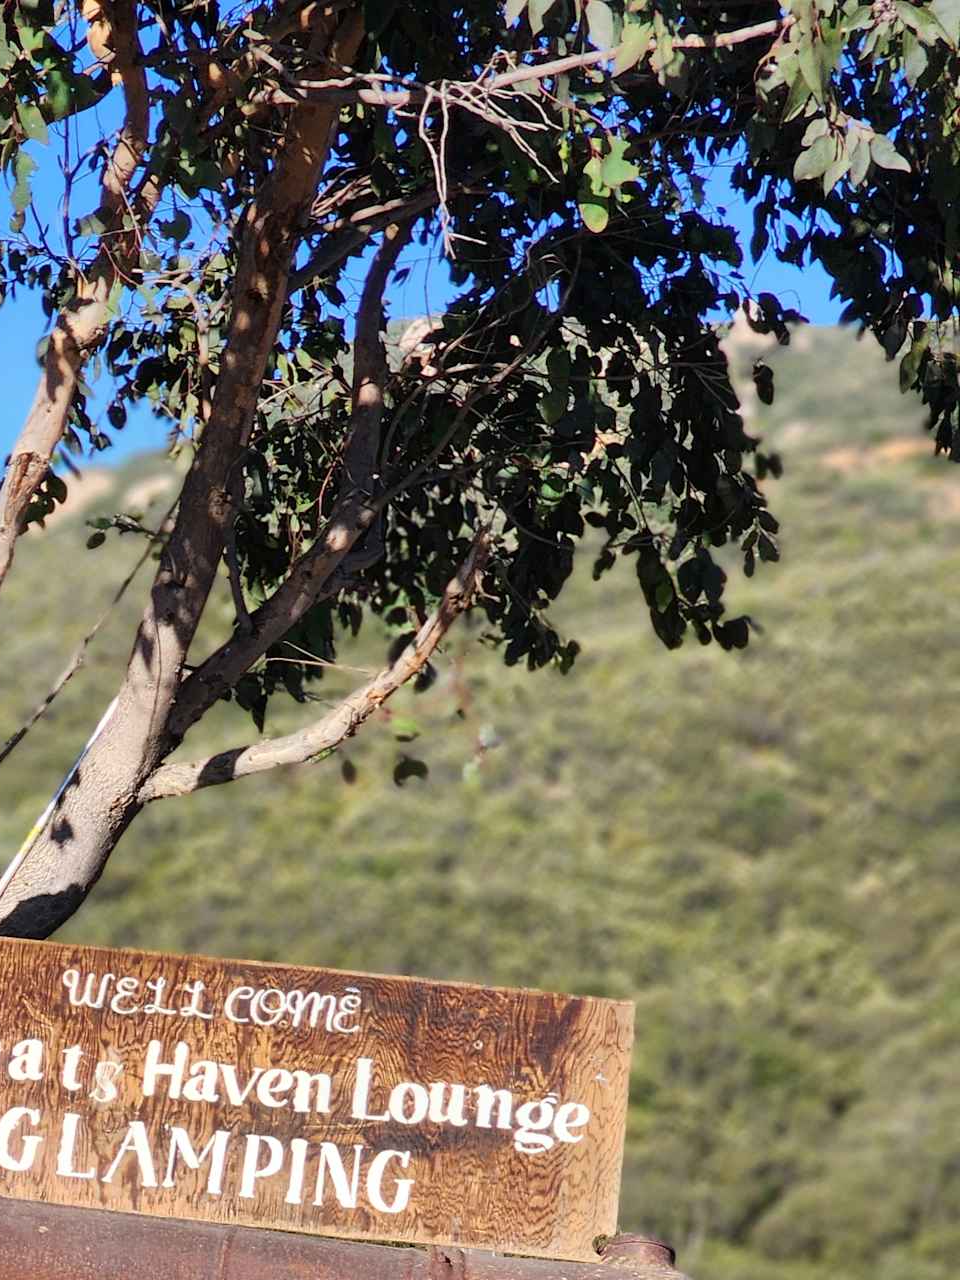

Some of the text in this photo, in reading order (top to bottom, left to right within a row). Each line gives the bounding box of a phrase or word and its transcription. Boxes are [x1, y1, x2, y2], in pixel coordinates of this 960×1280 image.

[62, 968, 214, 1020] WELL
[142, 1039, 332, 1115] Haven
[350, 1056, 592, 1155] Lounge
